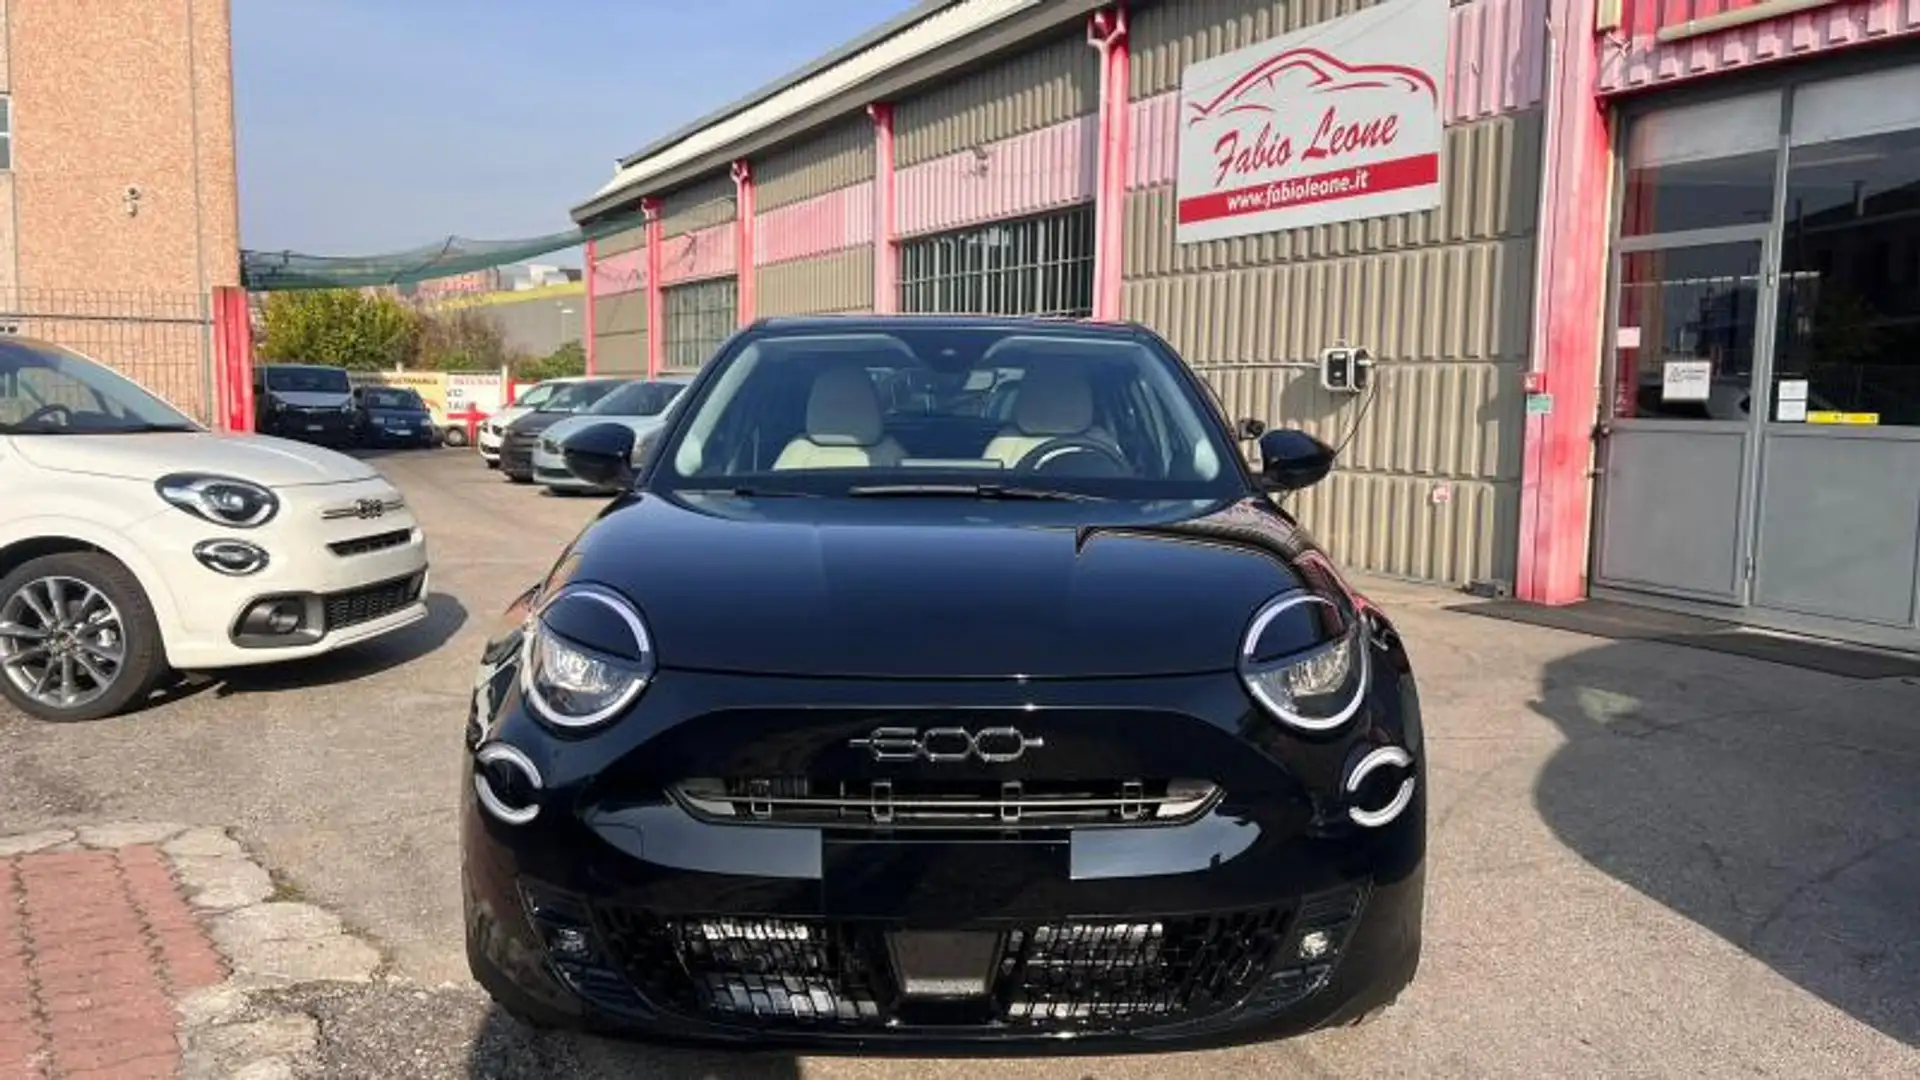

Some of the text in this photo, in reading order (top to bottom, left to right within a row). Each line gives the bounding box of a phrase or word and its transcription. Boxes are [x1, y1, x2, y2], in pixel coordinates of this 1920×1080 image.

[1214, 105, 1399, 187] Fabio Leone
[1228, 170, 1369, 212] www.fabioleone.it
